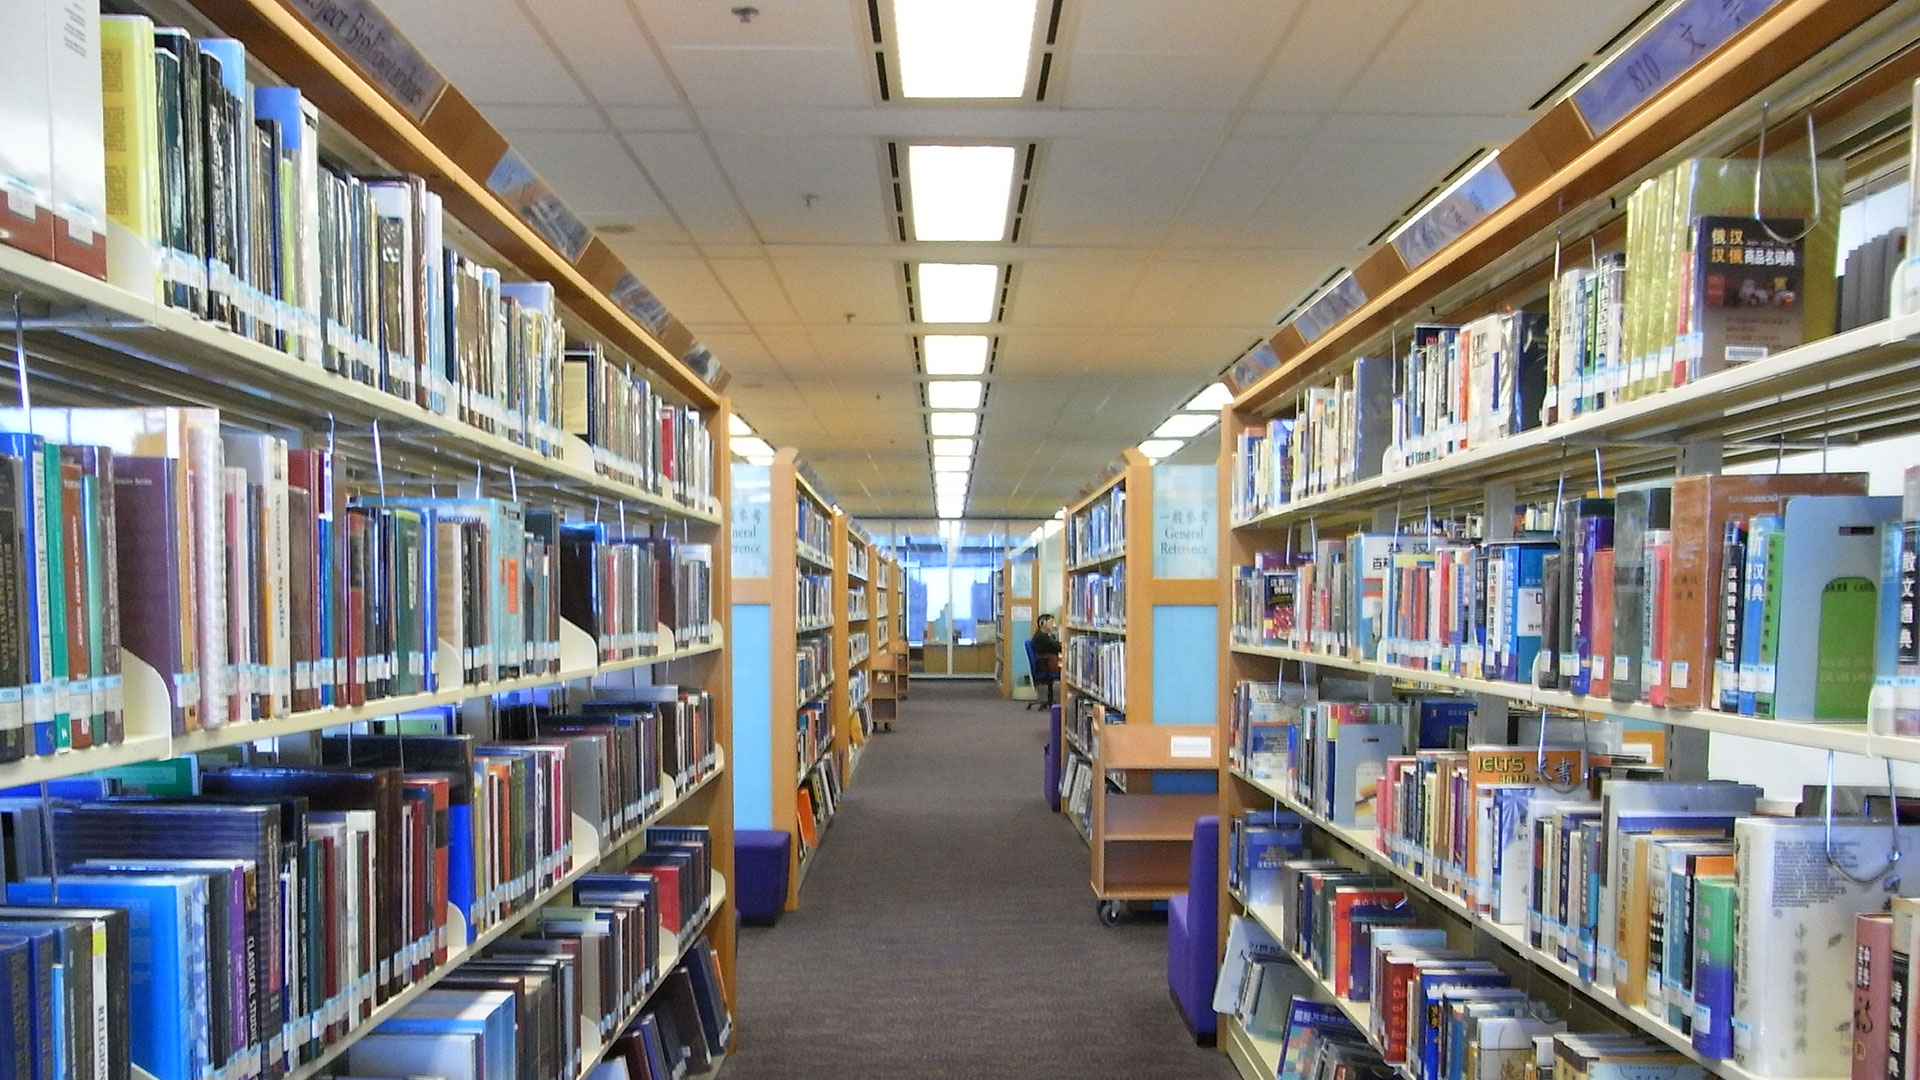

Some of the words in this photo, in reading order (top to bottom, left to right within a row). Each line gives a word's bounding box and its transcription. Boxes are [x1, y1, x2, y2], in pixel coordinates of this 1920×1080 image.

[1626, 53, 1661, 93] 810
[1745, 248, 1795, 266] 商品名词典
[1165, 528, 1203, 539] General
[1161, 542, 1208, 555] Reference
[1477, 756, 1525, 773] IELTS
[247, 936, 257, 998] CLASSICAL
